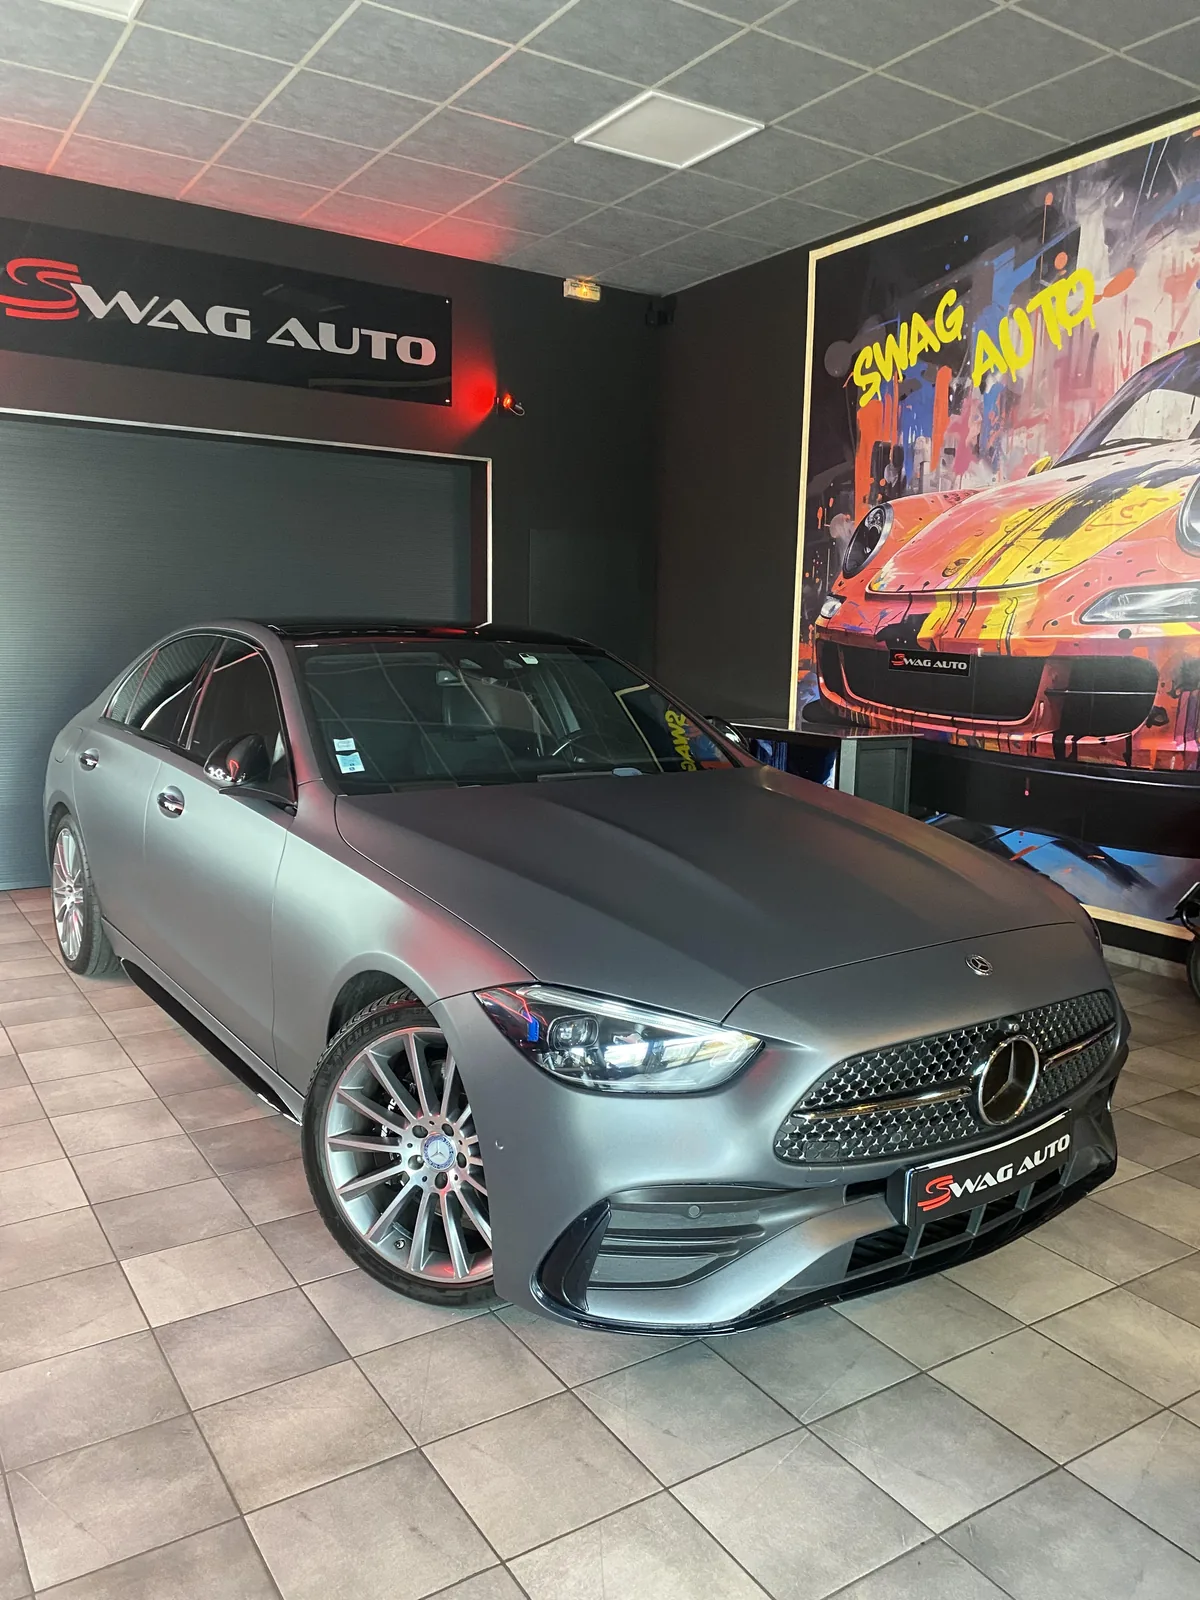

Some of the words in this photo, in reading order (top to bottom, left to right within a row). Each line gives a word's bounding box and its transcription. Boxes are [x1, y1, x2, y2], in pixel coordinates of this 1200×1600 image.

[0, 258, 251, 340] SWAG
[266, 317, 437, 366] AUTO
[853, 288, 964, 408] SWAG
[972, 268, 1096, 388] AUTO
[891, 653, 931, 667] SWAG
[933, 660, 967, 670] AUTO
[333, 1012, 397, 1064] MICHELIN
[917, 1163, 1013, 1212] SWAG
[1017, 1133, 1070, 1176] AUTO
